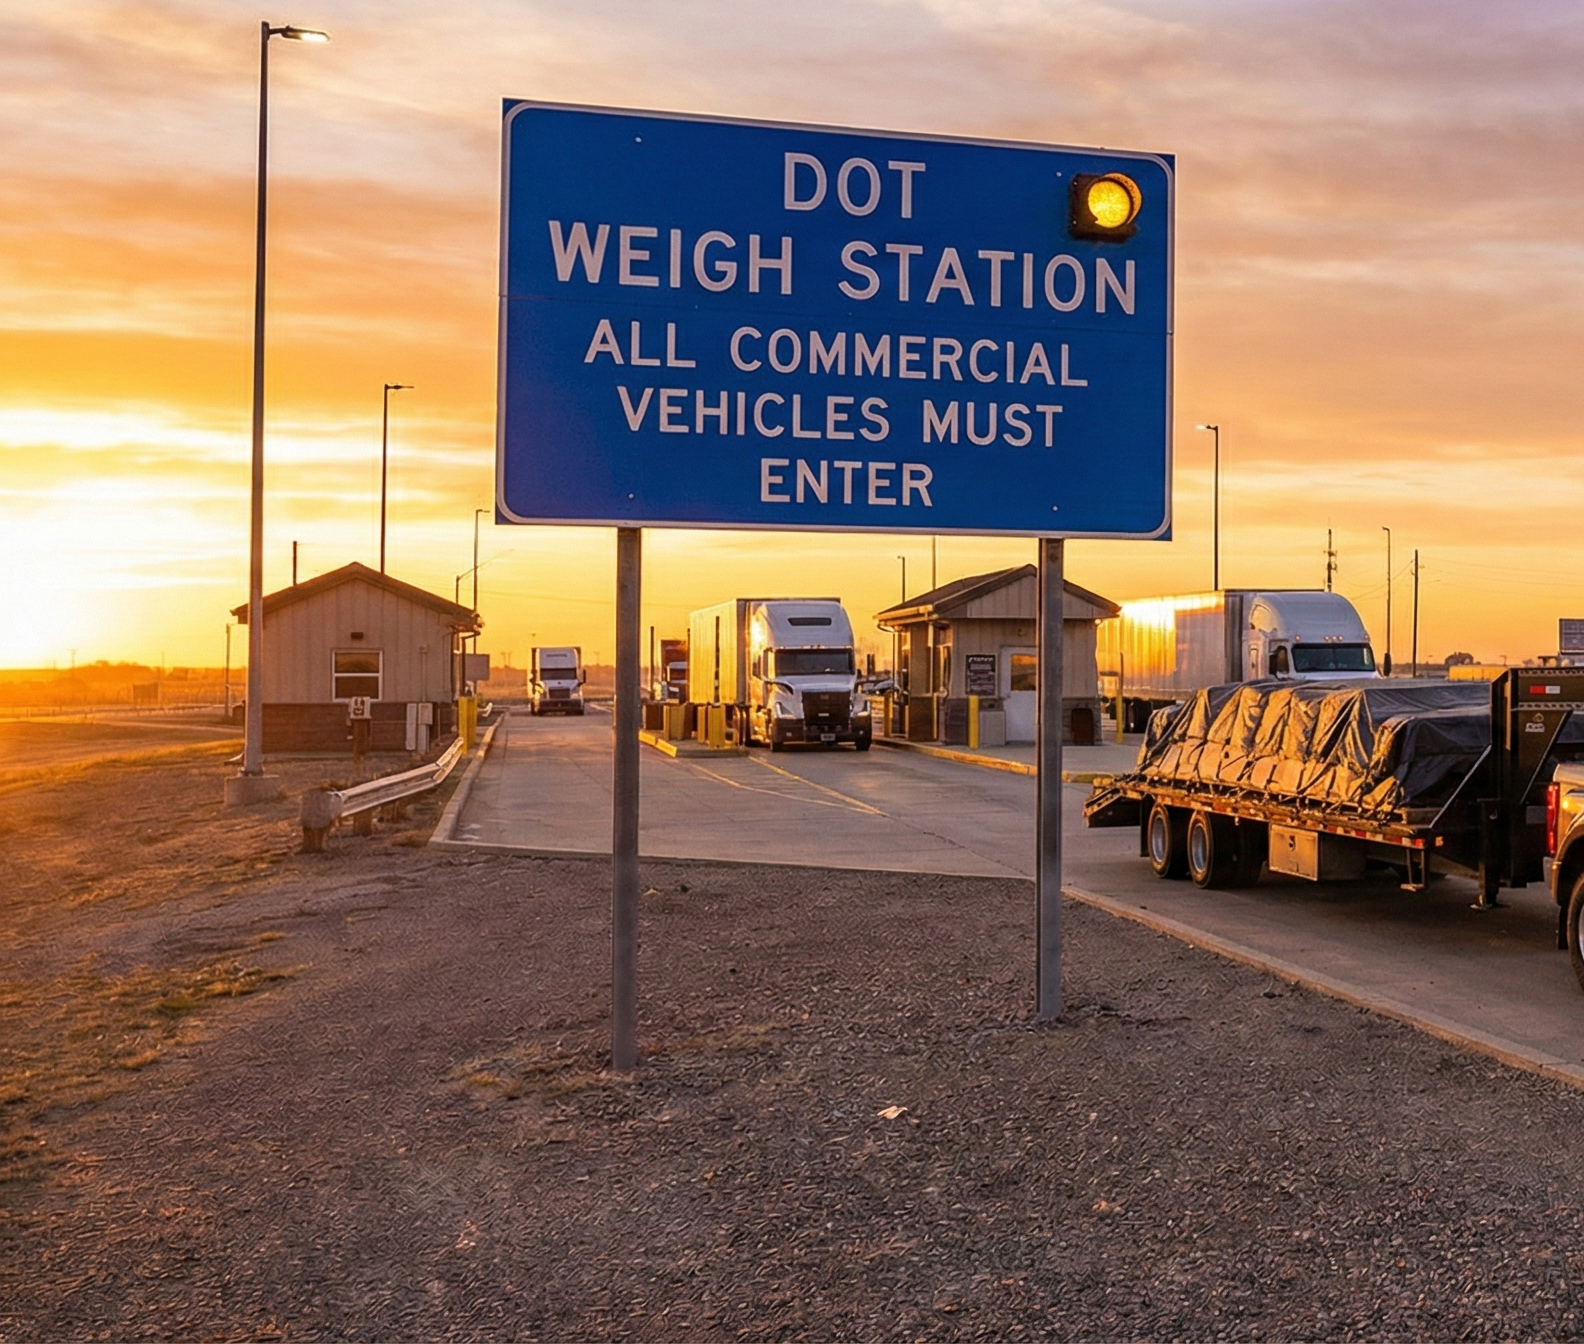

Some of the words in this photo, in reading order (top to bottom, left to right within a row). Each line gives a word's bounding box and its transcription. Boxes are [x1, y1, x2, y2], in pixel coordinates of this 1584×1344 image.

[785, 152, 926, 219] DOT
[548, 220, 793, 295] WEIGH
[838, 240, 1136, 315] STATION
[584, 319, 697, 368] ALL
[730, 326, 1089, 387] COMMERCIAL
[617, 385, 890, 442] VEHICLES
[922, 399, 1063, 448] MUST
[760, 457, 934, 507] ENTER
